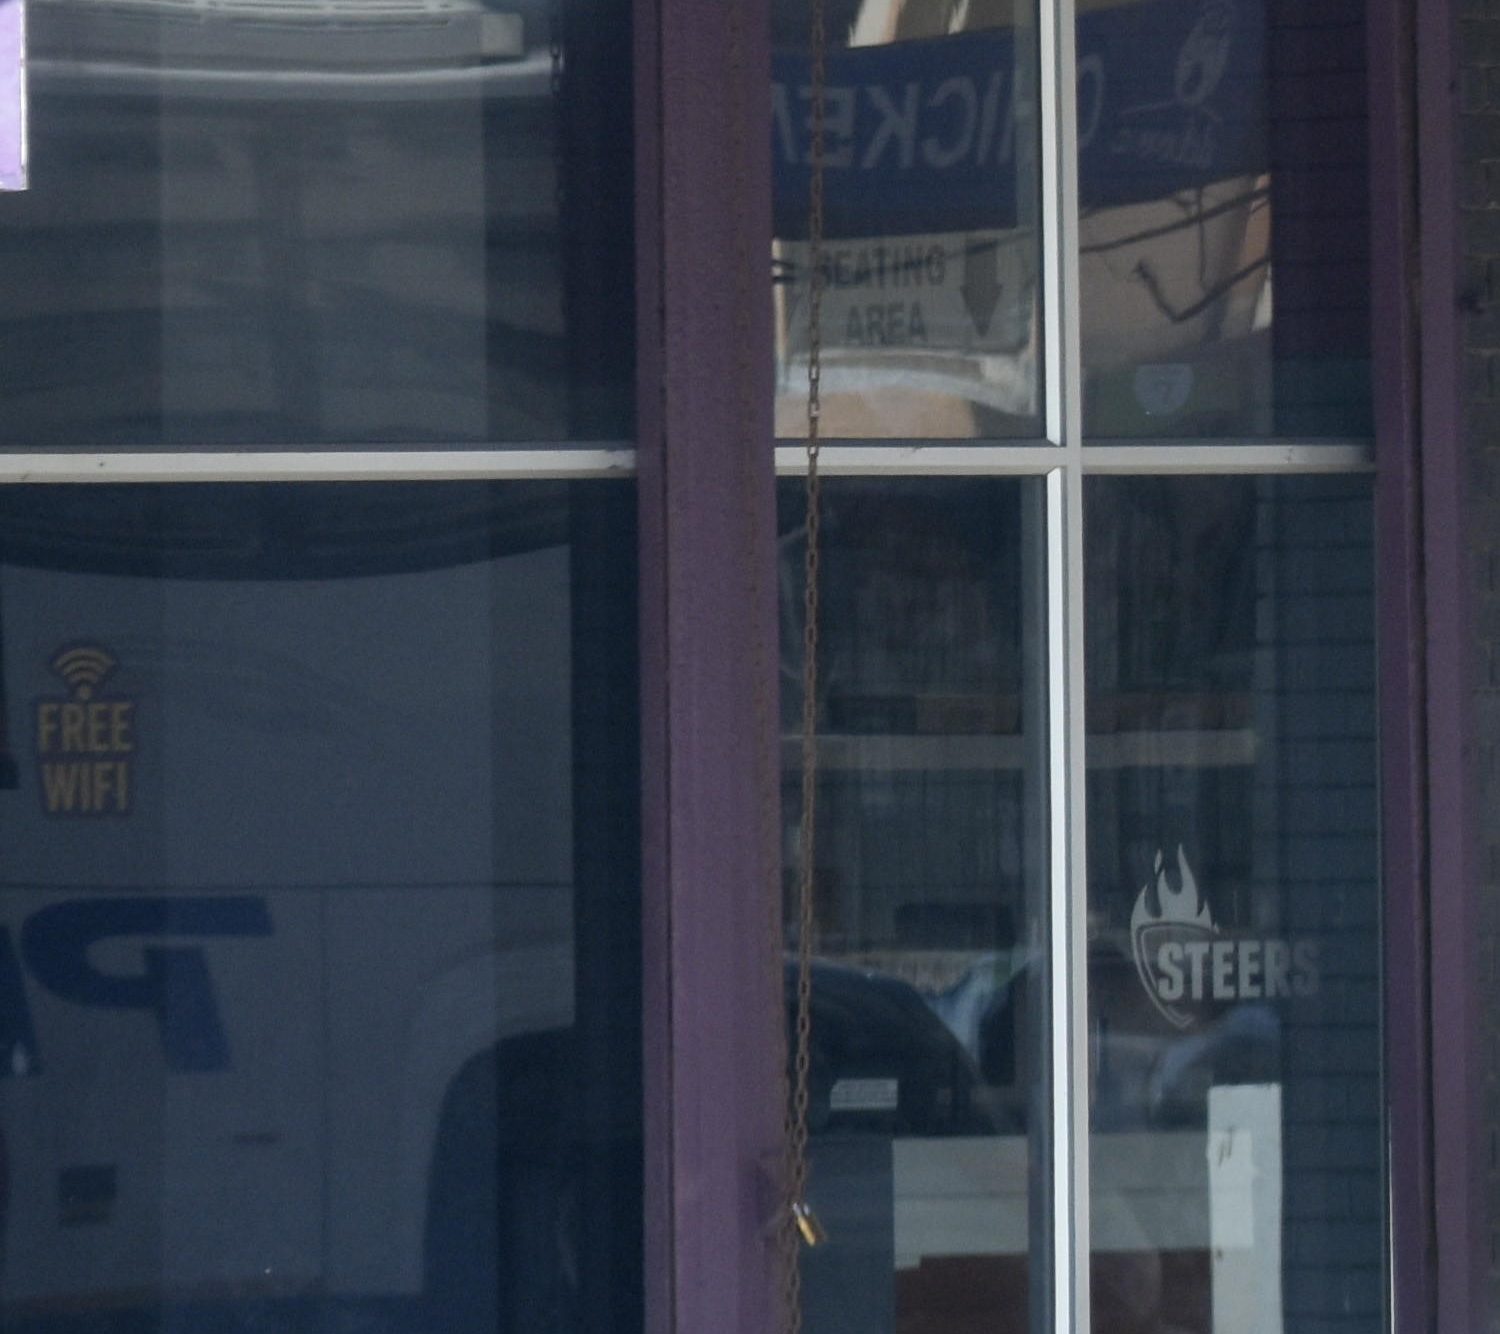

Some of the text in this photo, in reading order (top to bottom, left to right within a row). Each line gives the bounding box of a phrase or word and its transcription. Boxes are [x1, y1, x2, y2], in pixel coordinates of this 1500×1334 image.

[843, 301, 929, 345] AREA
[36, 701, 134, 754] FREE
[40, 761, 130, 814] WIFI
[1156, 939, 1321, 1001] STEERS
